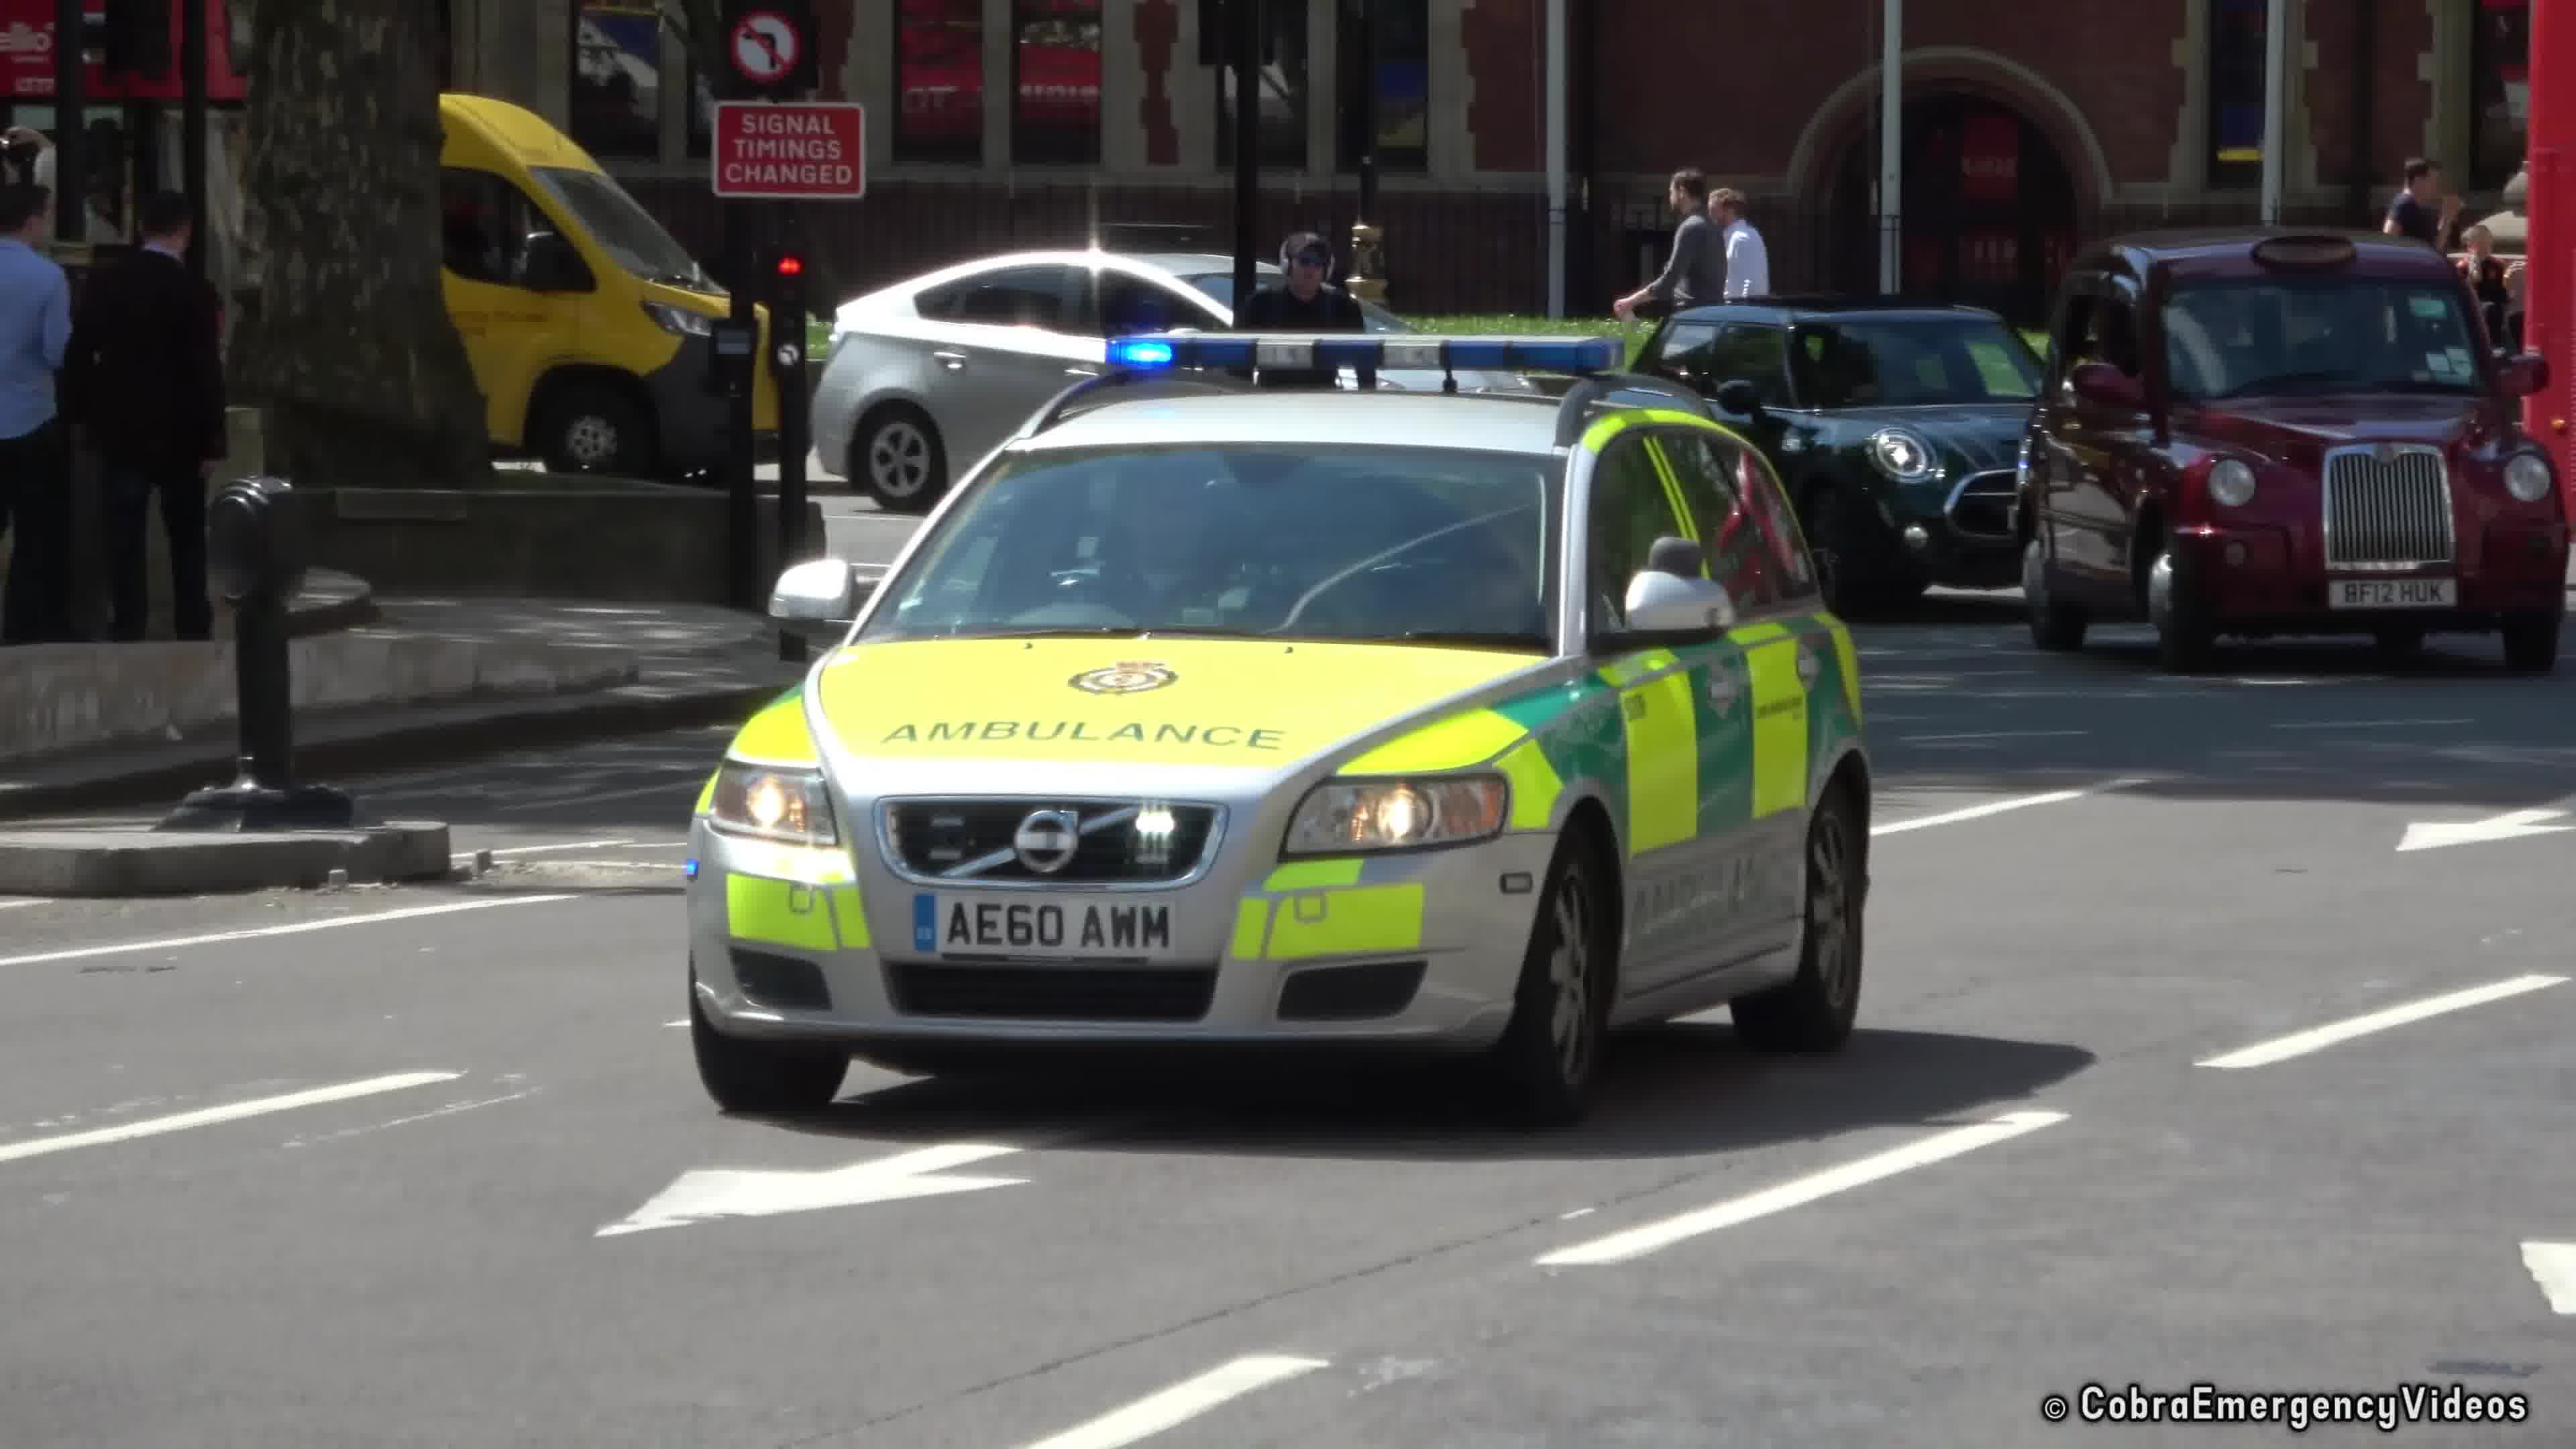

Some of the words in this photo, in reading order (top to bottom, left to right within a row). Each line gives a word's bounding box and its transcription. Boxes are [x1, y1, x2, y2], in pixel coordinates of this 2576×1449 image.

[741, 113, 836, 134] SIGNAL
[733, 138, 843, 160] TIMINGS
[724, 163, 853, 185] CHANGED
[2345, 583, 2394, 604] BF12
[2399, 582, 2444, 602] HUK
[880, 720, 1287, 750] AMBULANCE
[947, 902, 1065, 947] AE60
[1080, 904, 1169, 949] AWM
